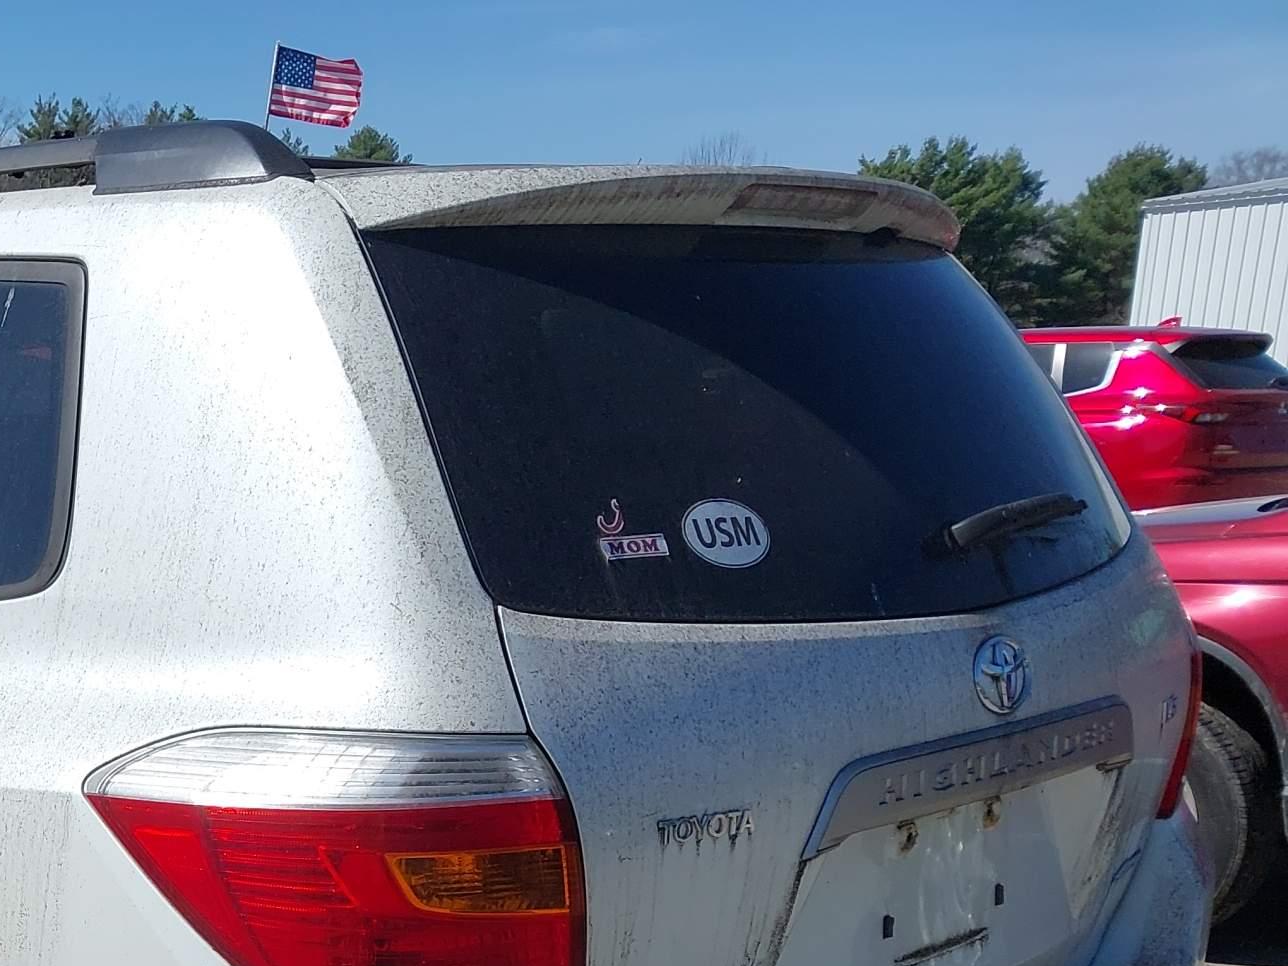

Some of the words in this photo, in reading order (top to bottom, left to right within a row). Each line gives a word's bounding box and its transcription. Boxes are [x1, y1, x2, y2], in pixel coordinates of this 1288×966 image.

[607, 538, 661, 556] MOM
[691, 515, 761, 550] USM
[657, 808, 755, 847] TOYOTA
